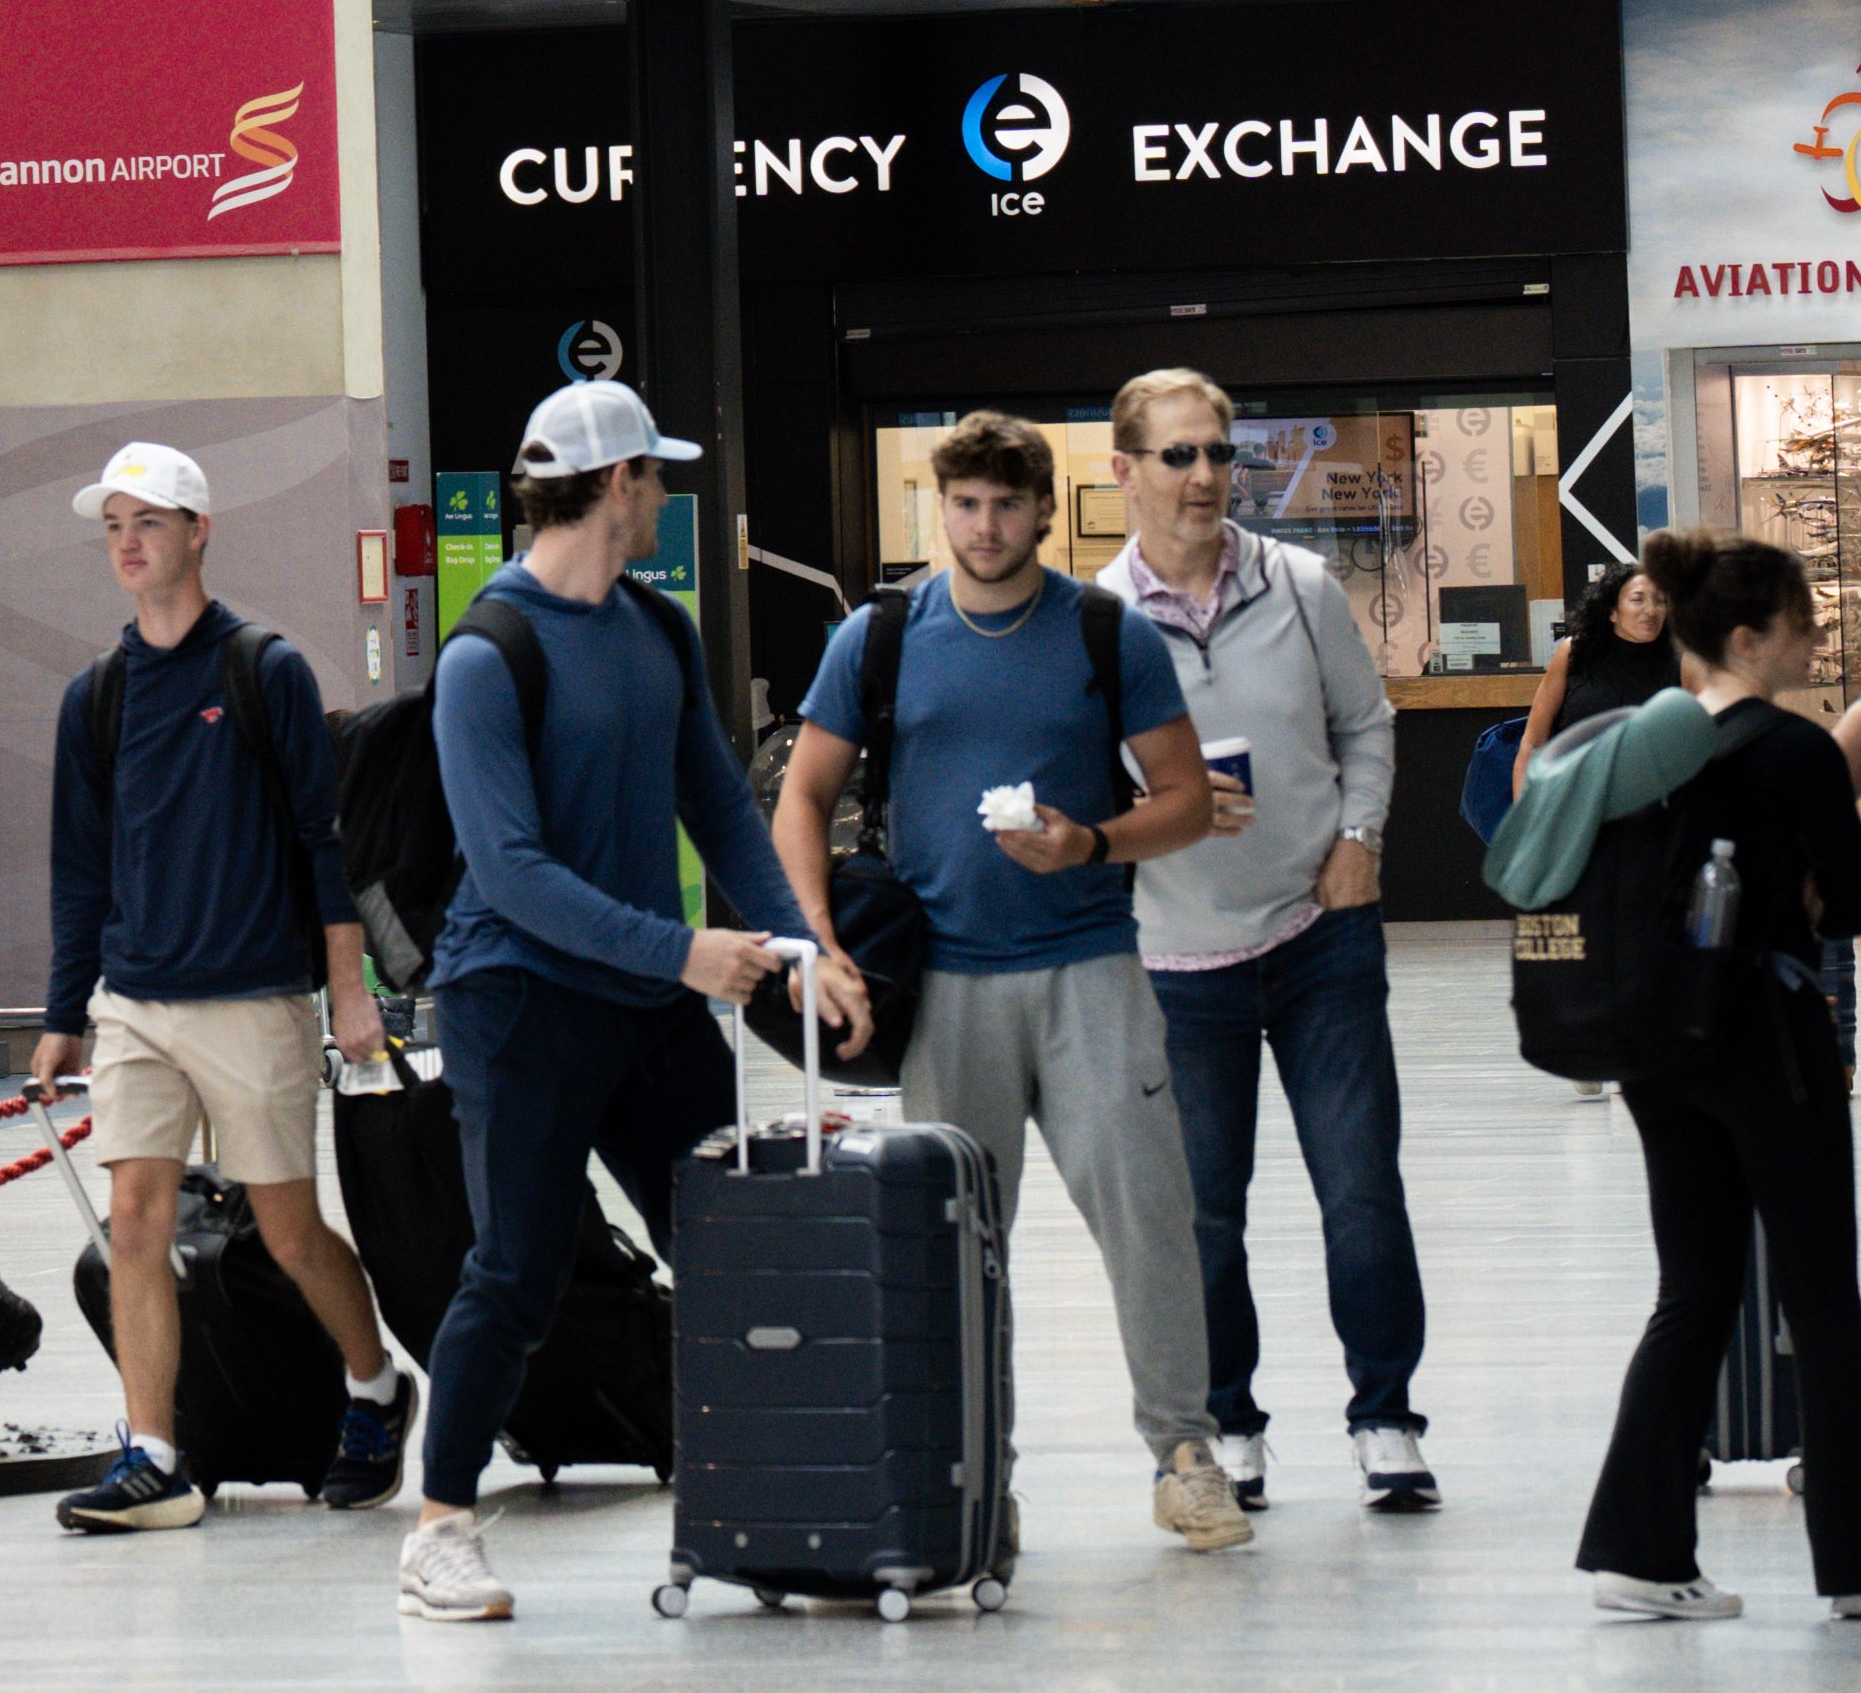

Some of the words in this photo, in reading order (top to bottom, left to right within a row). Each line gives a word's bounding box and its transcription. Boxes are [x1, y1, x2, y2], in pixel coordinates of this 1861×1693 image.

[112, 153, 226, 182] AIRPORT
[499, 135, 906, 205] CURNCY
[1133, 109, 1548, 183] EXCHANGE
[1326, 472, 1361, 485] New
[1322, 488, 1356, 501] New
